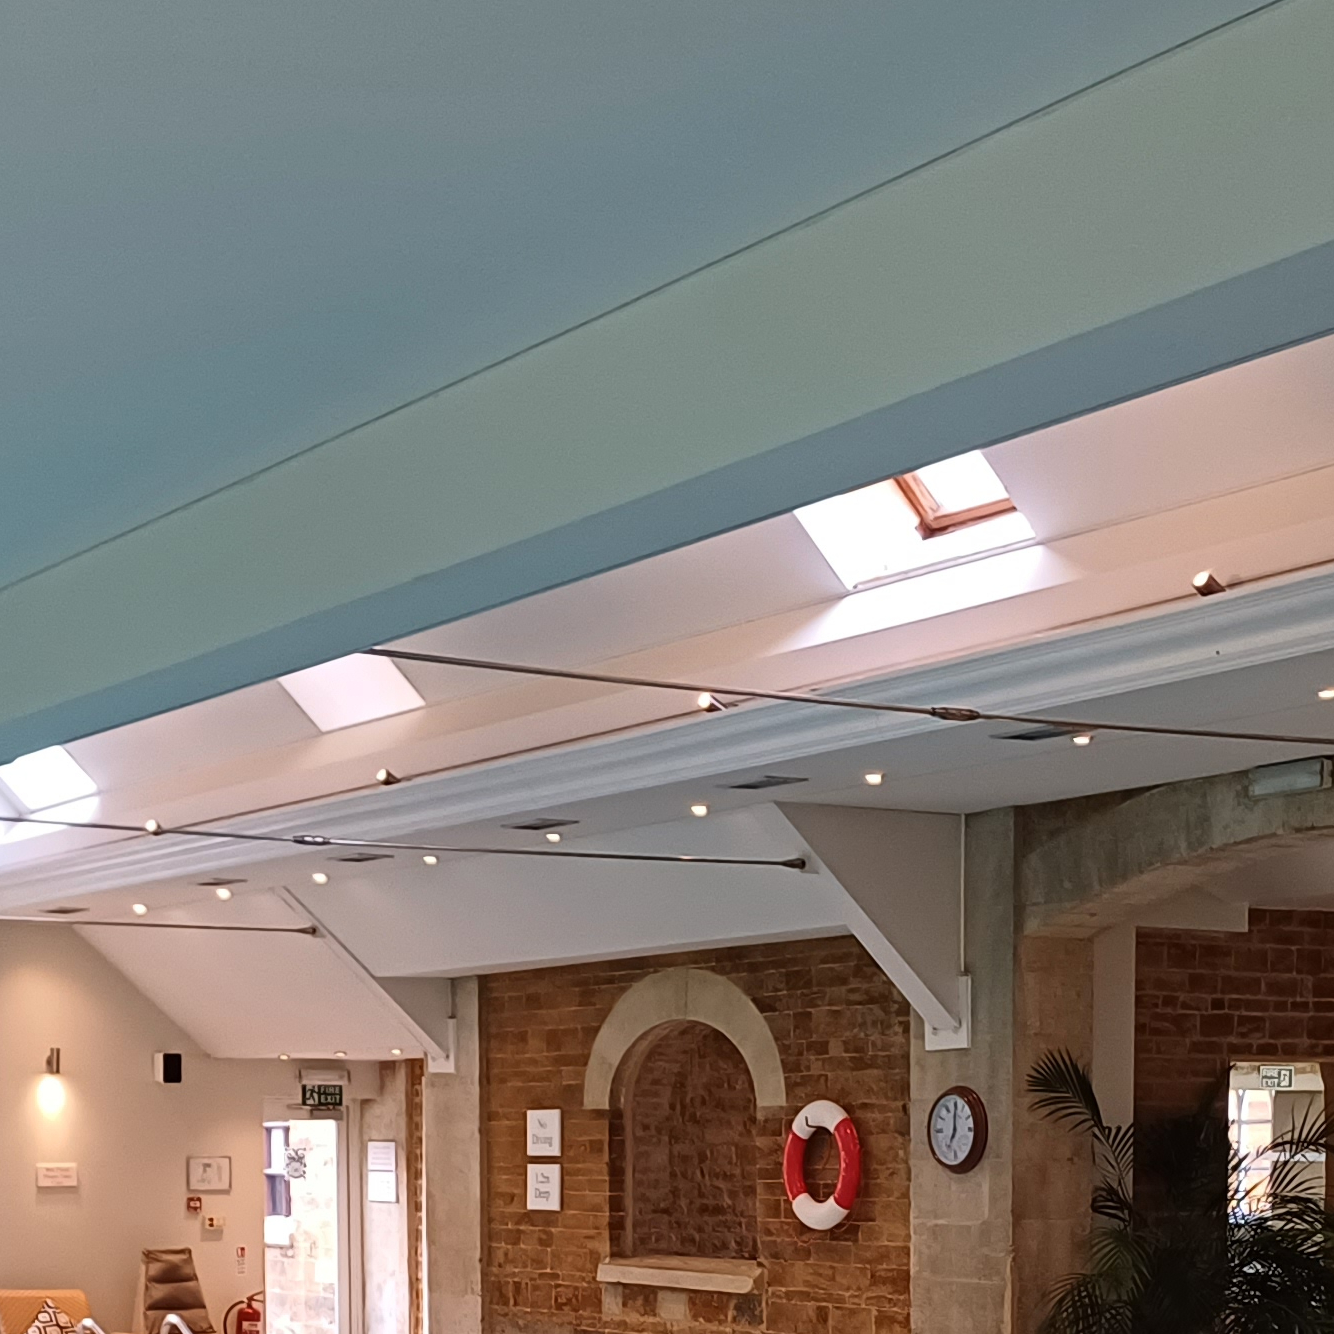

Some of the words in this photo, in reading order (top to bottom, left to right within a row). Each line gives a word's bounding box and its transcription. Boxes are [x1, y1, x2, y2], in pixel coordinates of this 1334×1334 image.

[1262, 1079, 1279, 1087] EXIT
[320, 1086, 340, 1094] FIRE
[320, 1094, 340, 1104] EXIT
